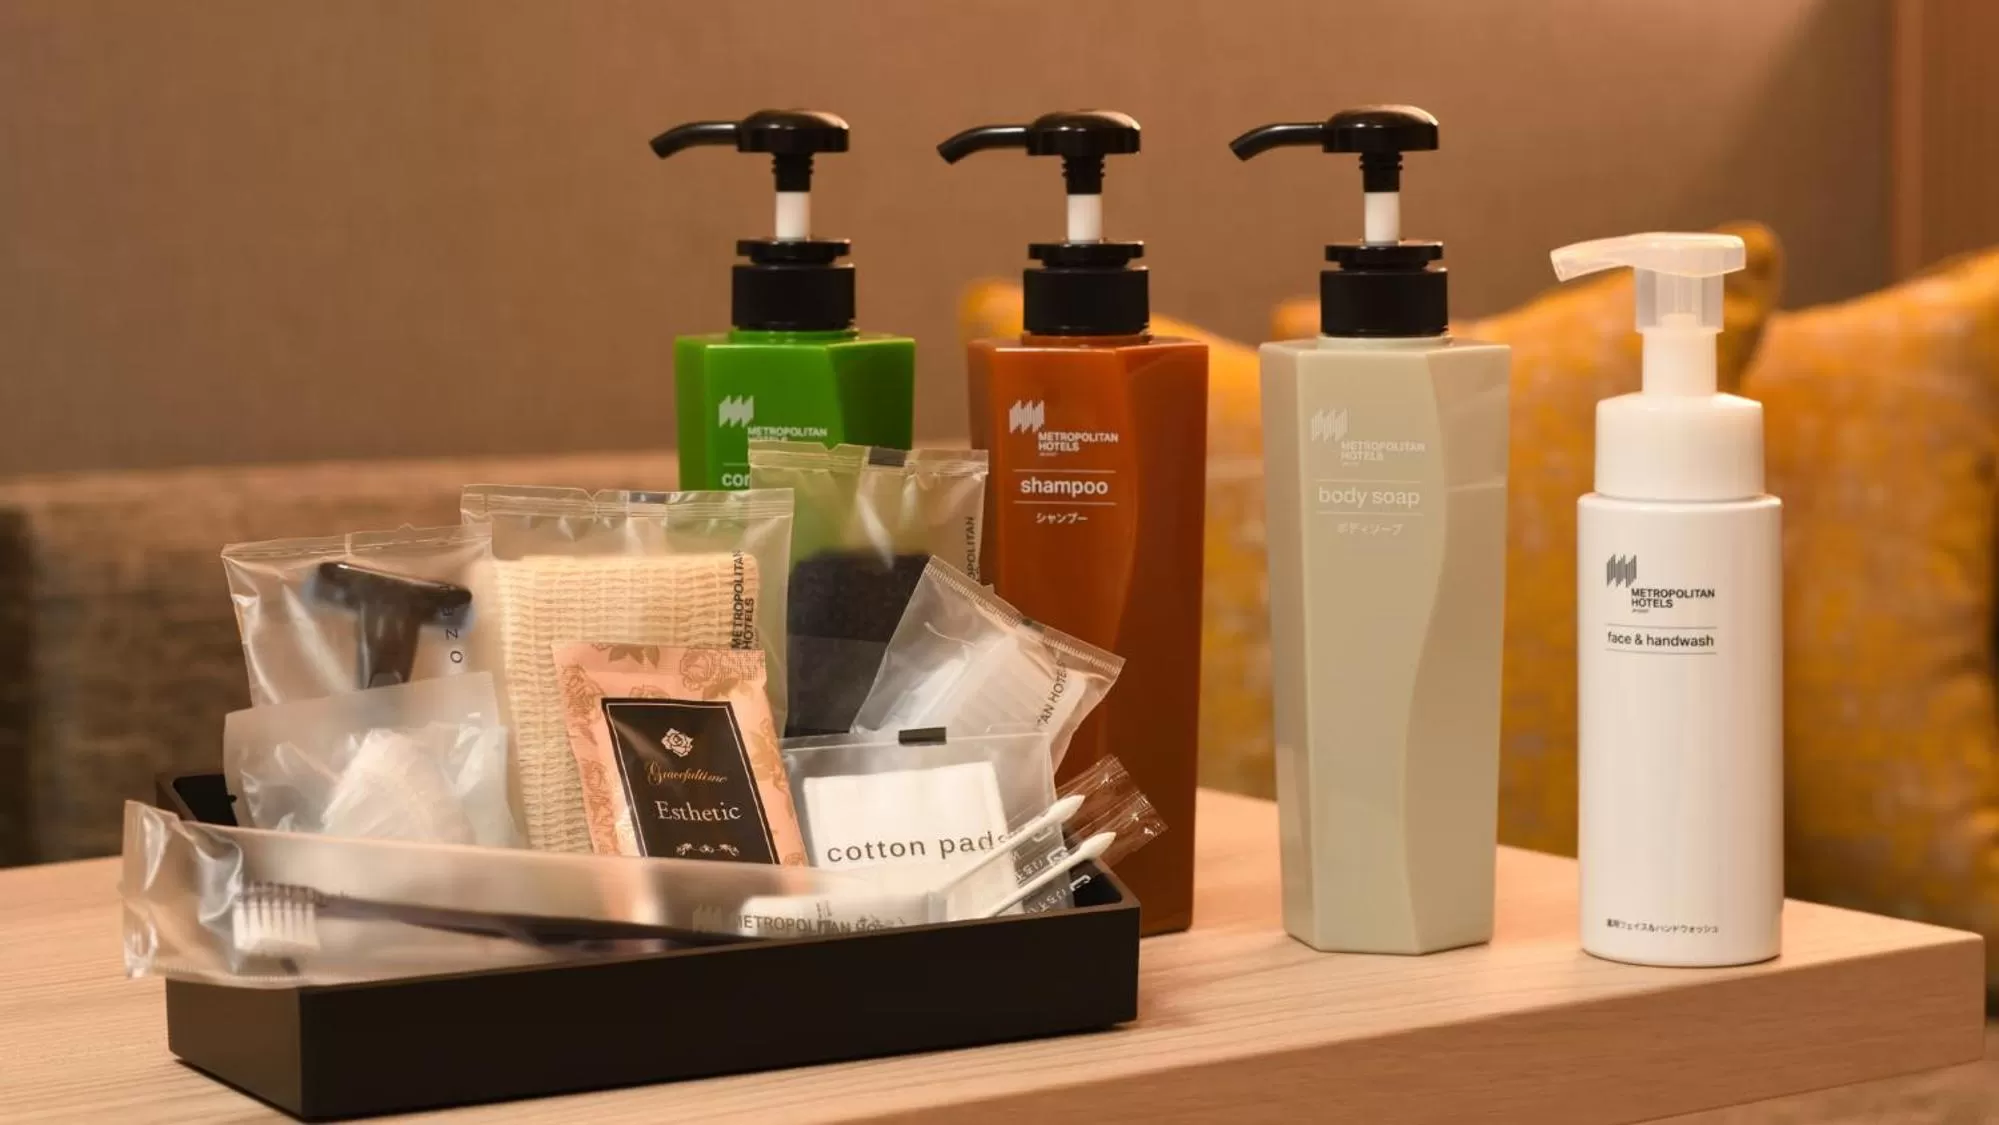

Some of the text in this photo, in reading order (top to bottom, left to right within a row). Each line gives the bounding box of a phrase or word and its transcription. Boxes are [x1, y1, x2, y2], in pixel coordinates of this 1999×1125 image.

[747, 426, 828, 438] METROPOLITAN
[1037, 431, 1119, 443] METROPOLITAN
[1038, 441, 1081, 452] HOTELS
[1340, 440, 1426, 452] METROPOLITAN
[1340, 451, 1385, 461] HOTELS
[1020, 476, 1109, 498] shampoo
[1318, 486, 1421, 509] body soap
[1035, 511, 1089, 525] シャンプー
[731, 549, 745, 650] METROPOLITAN
[1630, 588, 1716, 599] METROPOLITAN
[1630, 598, 1674, 609] HOTELS
[741, 597, 755, 650] HOTELS
[1607, 631, 1715, 648] face & handwash
[655, 800, 742, 822] Esthetic
[826, 837, 927, 862] cotton
